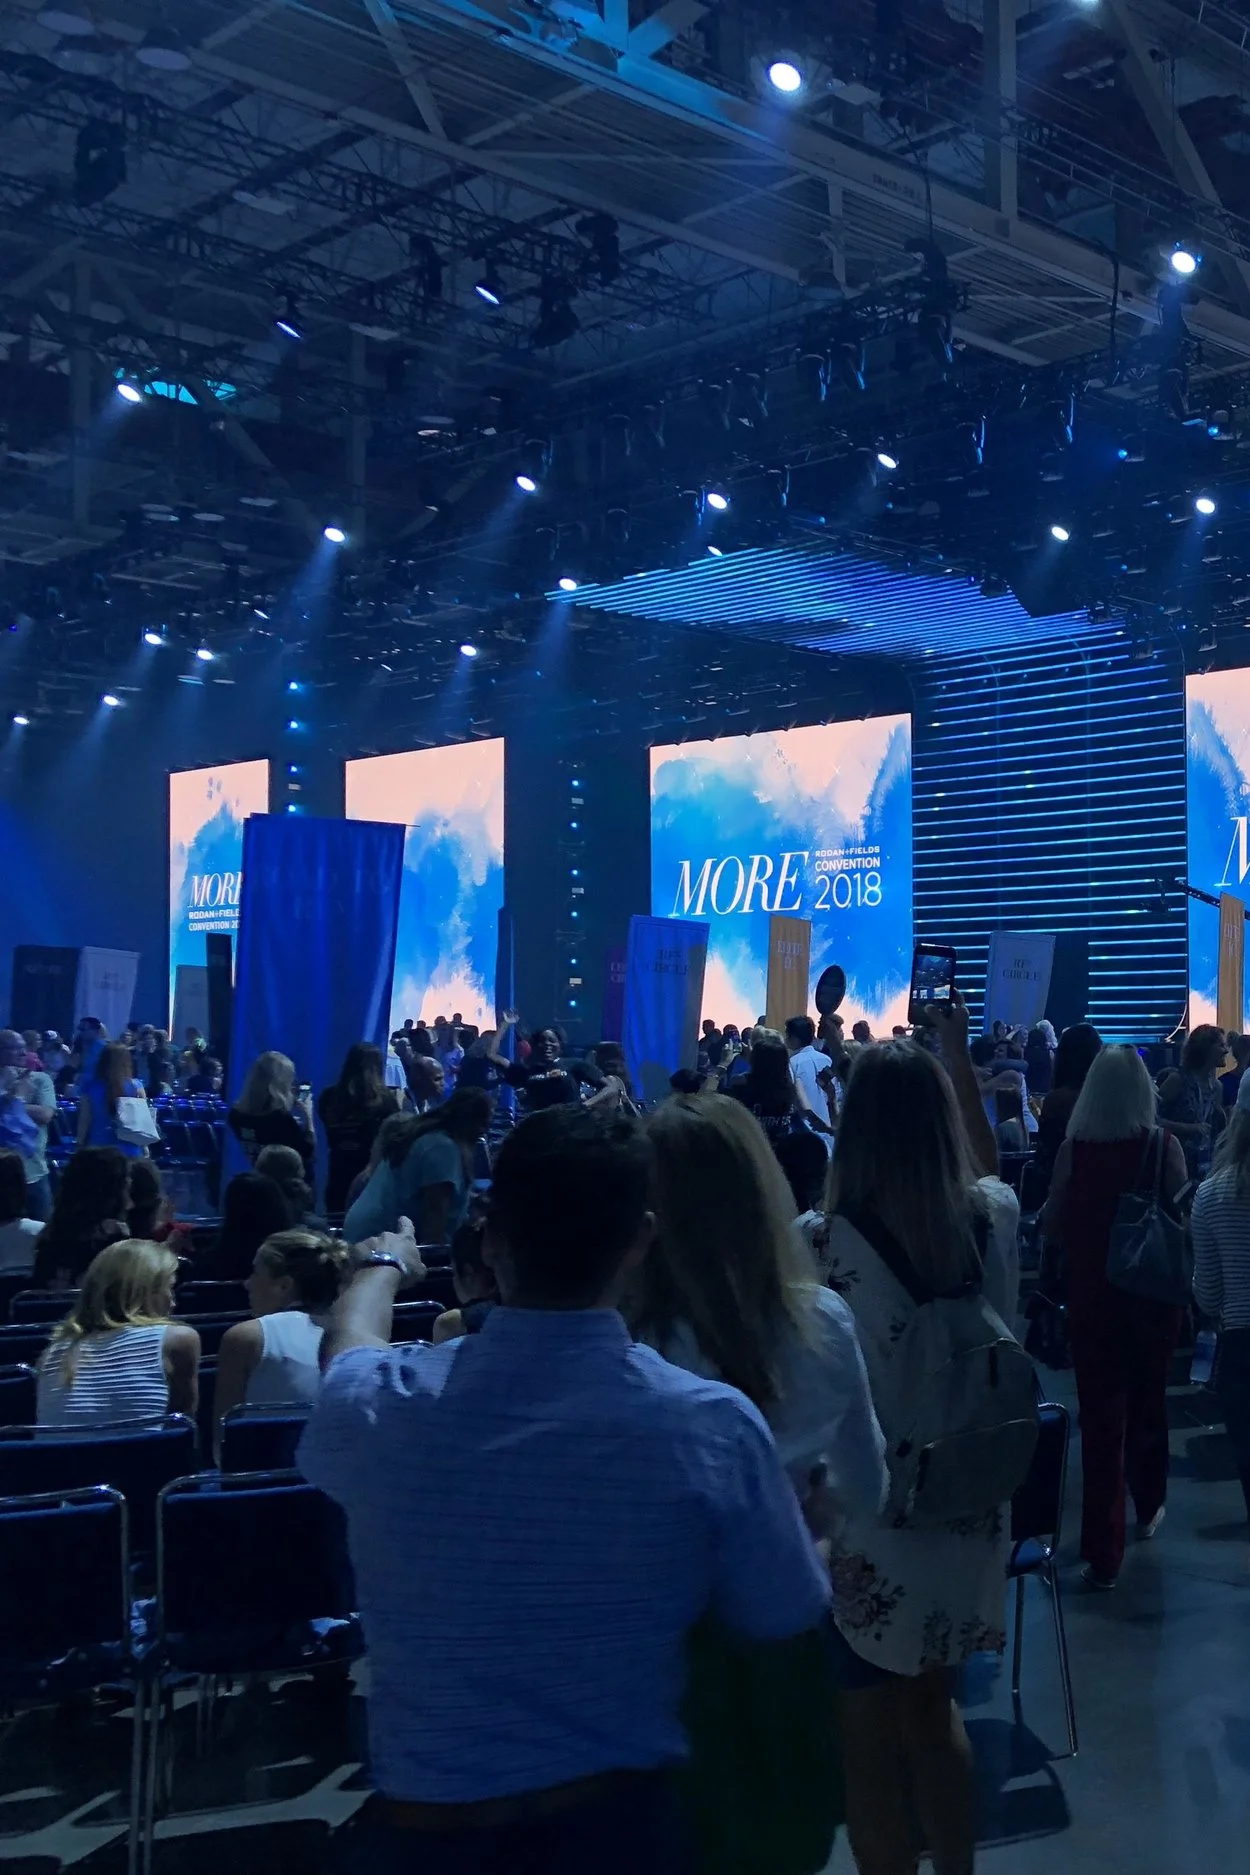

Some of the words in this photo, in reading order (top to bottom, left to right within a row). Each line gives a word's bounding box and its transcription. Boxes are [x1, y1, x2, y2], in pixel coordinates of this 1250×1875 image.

[815, 846, 880, 857] RODAN+FIELDS
[815, 857, 881, 872] CONVENTION
[668, 851, 809, 917] MORE
[815, 871, 882, 910] 2018
[189, 920, 230, 931] CONVENTION
